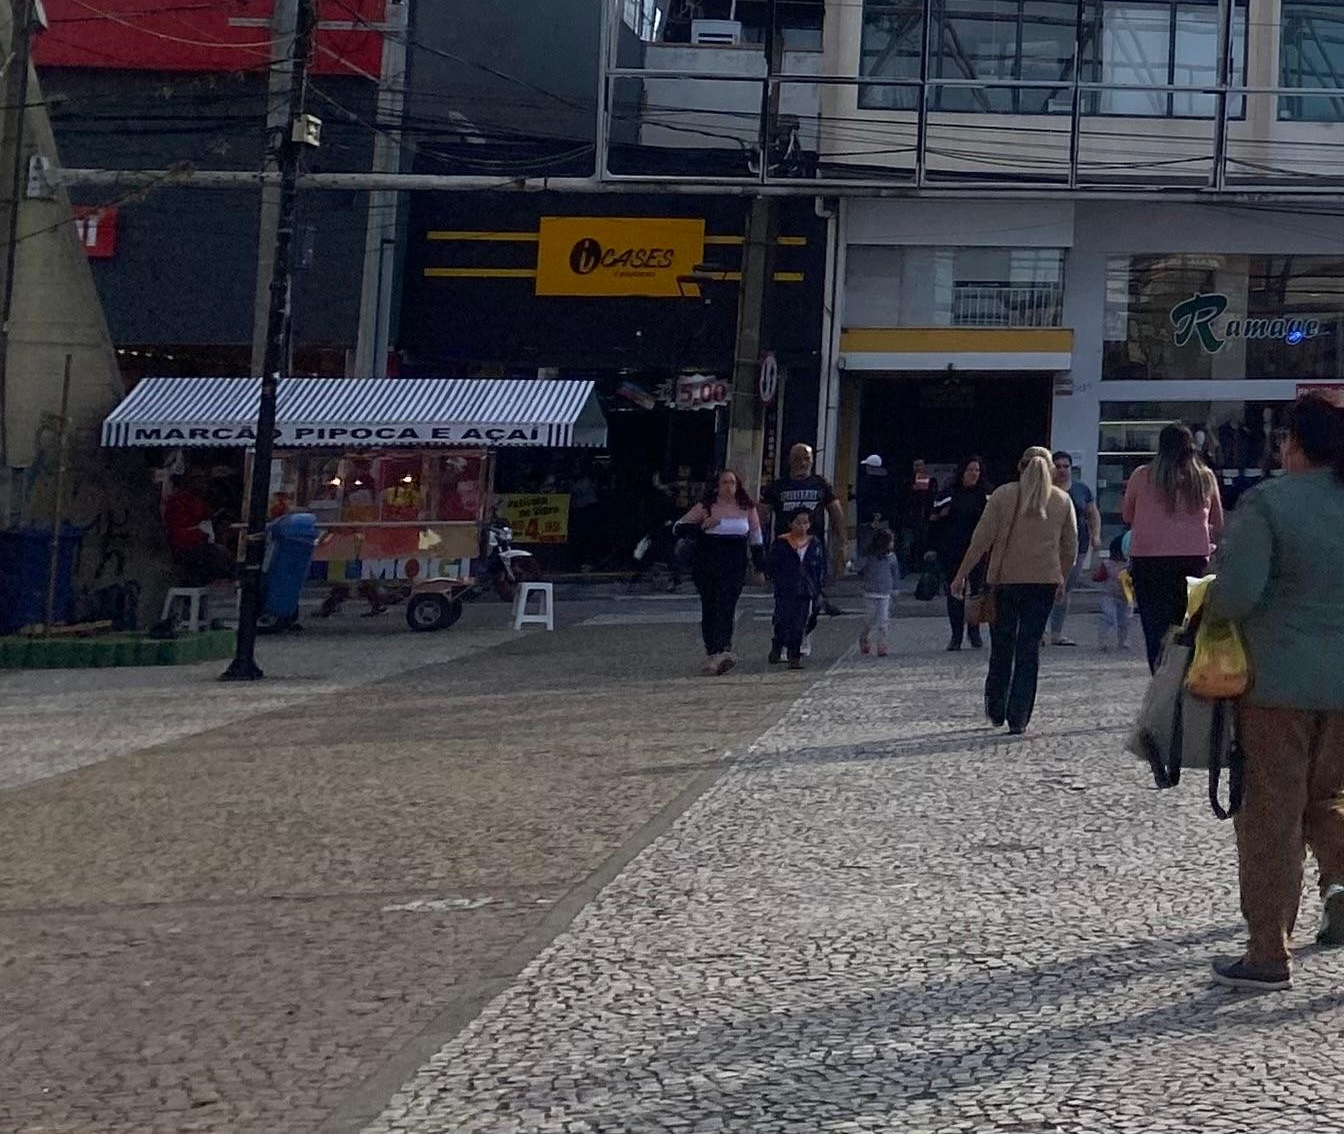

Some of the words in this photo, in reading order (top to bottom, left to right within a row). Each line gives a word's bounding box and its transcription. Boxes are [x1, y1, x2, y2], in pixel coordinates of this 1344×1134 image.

[295, 427, 419, 441] PIPOCA
[432, 427, 450, 441] E
[461, 426, 540, 444] AÇAÍ
